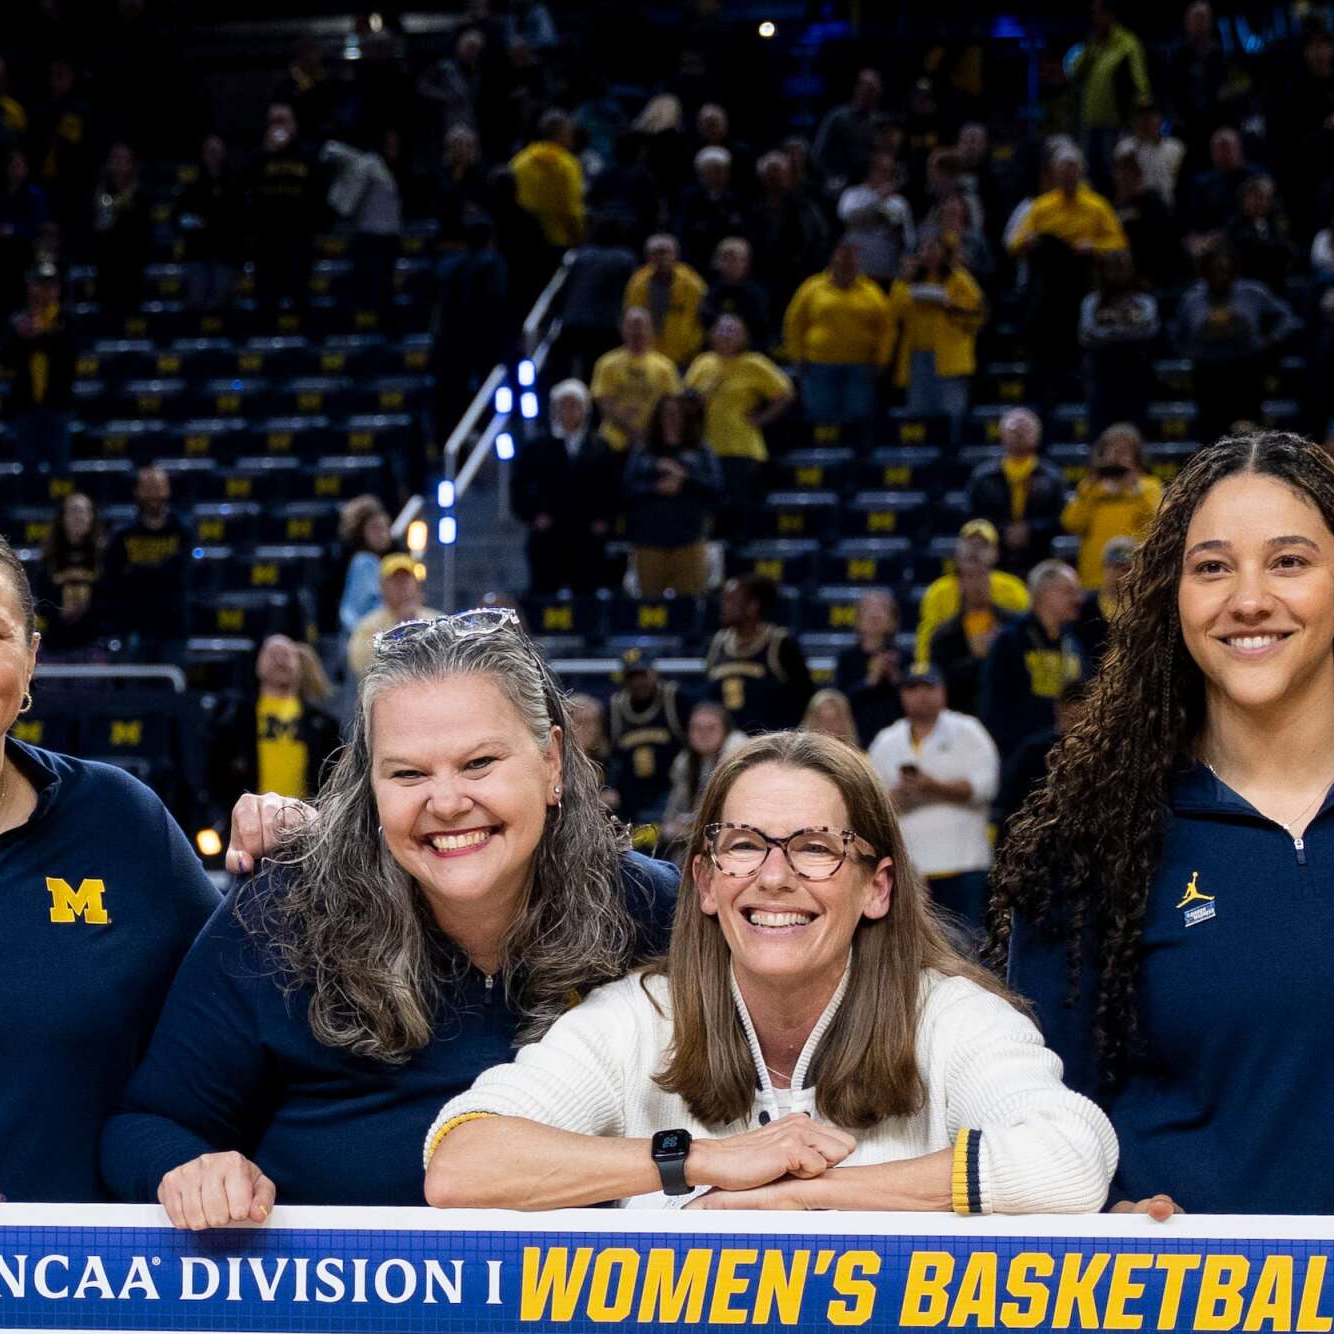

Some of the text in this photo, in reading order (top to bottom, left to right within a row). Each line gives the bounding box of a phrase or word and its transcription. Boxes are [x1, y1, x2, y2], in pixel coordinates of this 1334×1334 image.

[46, 877, 108, 924] M
[180, 1257, 463, 1305] DIVISION
[486, 1260, 503, 1305] I
[521, 1248, 879, 1324] WOMEN'S
